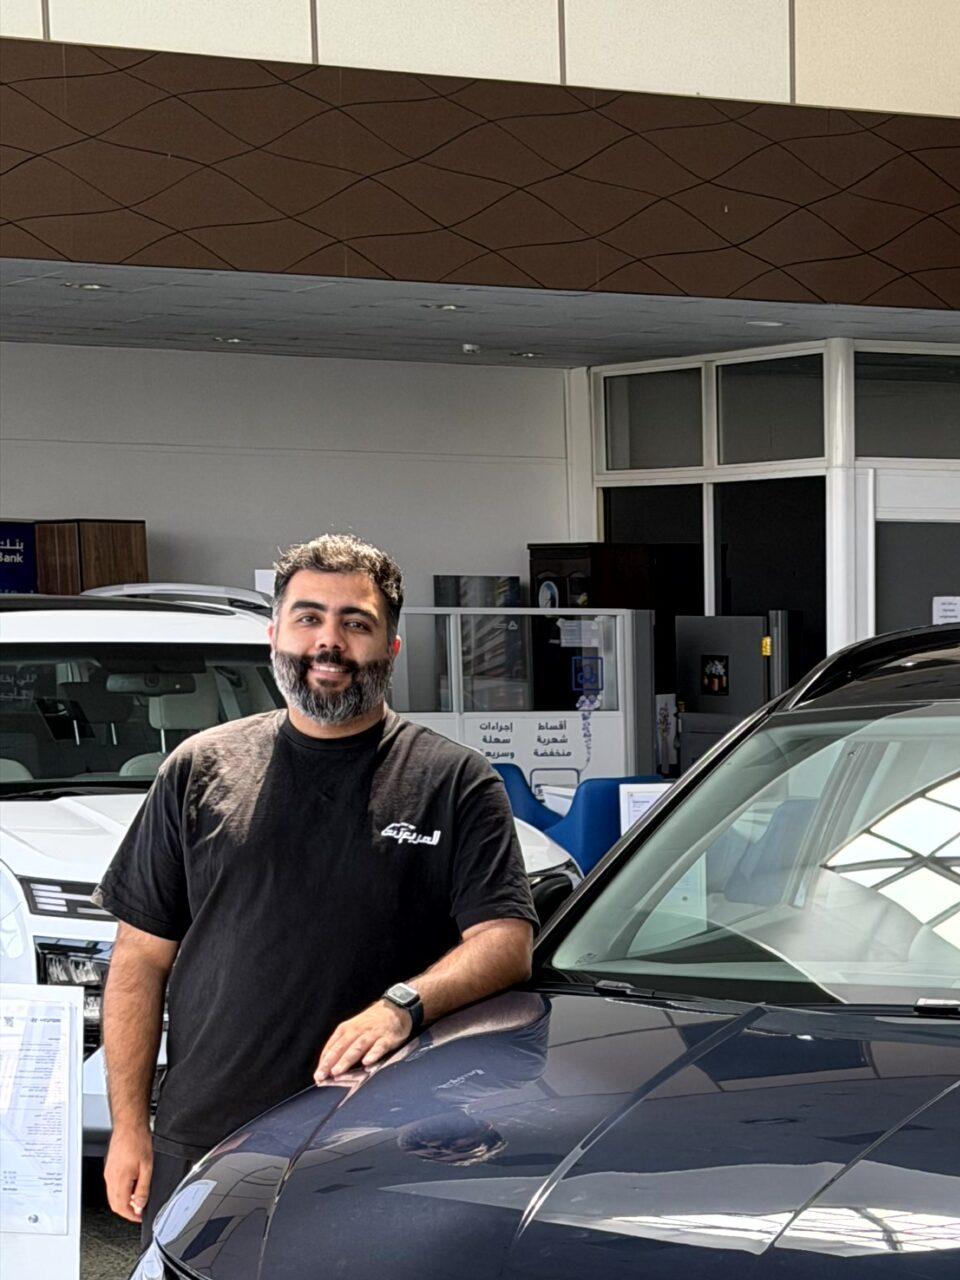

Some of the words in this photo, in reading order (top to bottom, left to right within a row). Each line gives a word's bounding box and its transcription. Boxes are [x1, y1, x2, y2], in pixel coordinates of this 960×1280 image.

[479, 721, 513, 732] إجراءات
[537, 719, 567, 731] أقساط
[482, 734, 511, 744] سهلة
[536, 734, 568, 746] شهرية
[481, 749, 515, 759] وسريع
[533, 748, 572, 757] منخفضة
